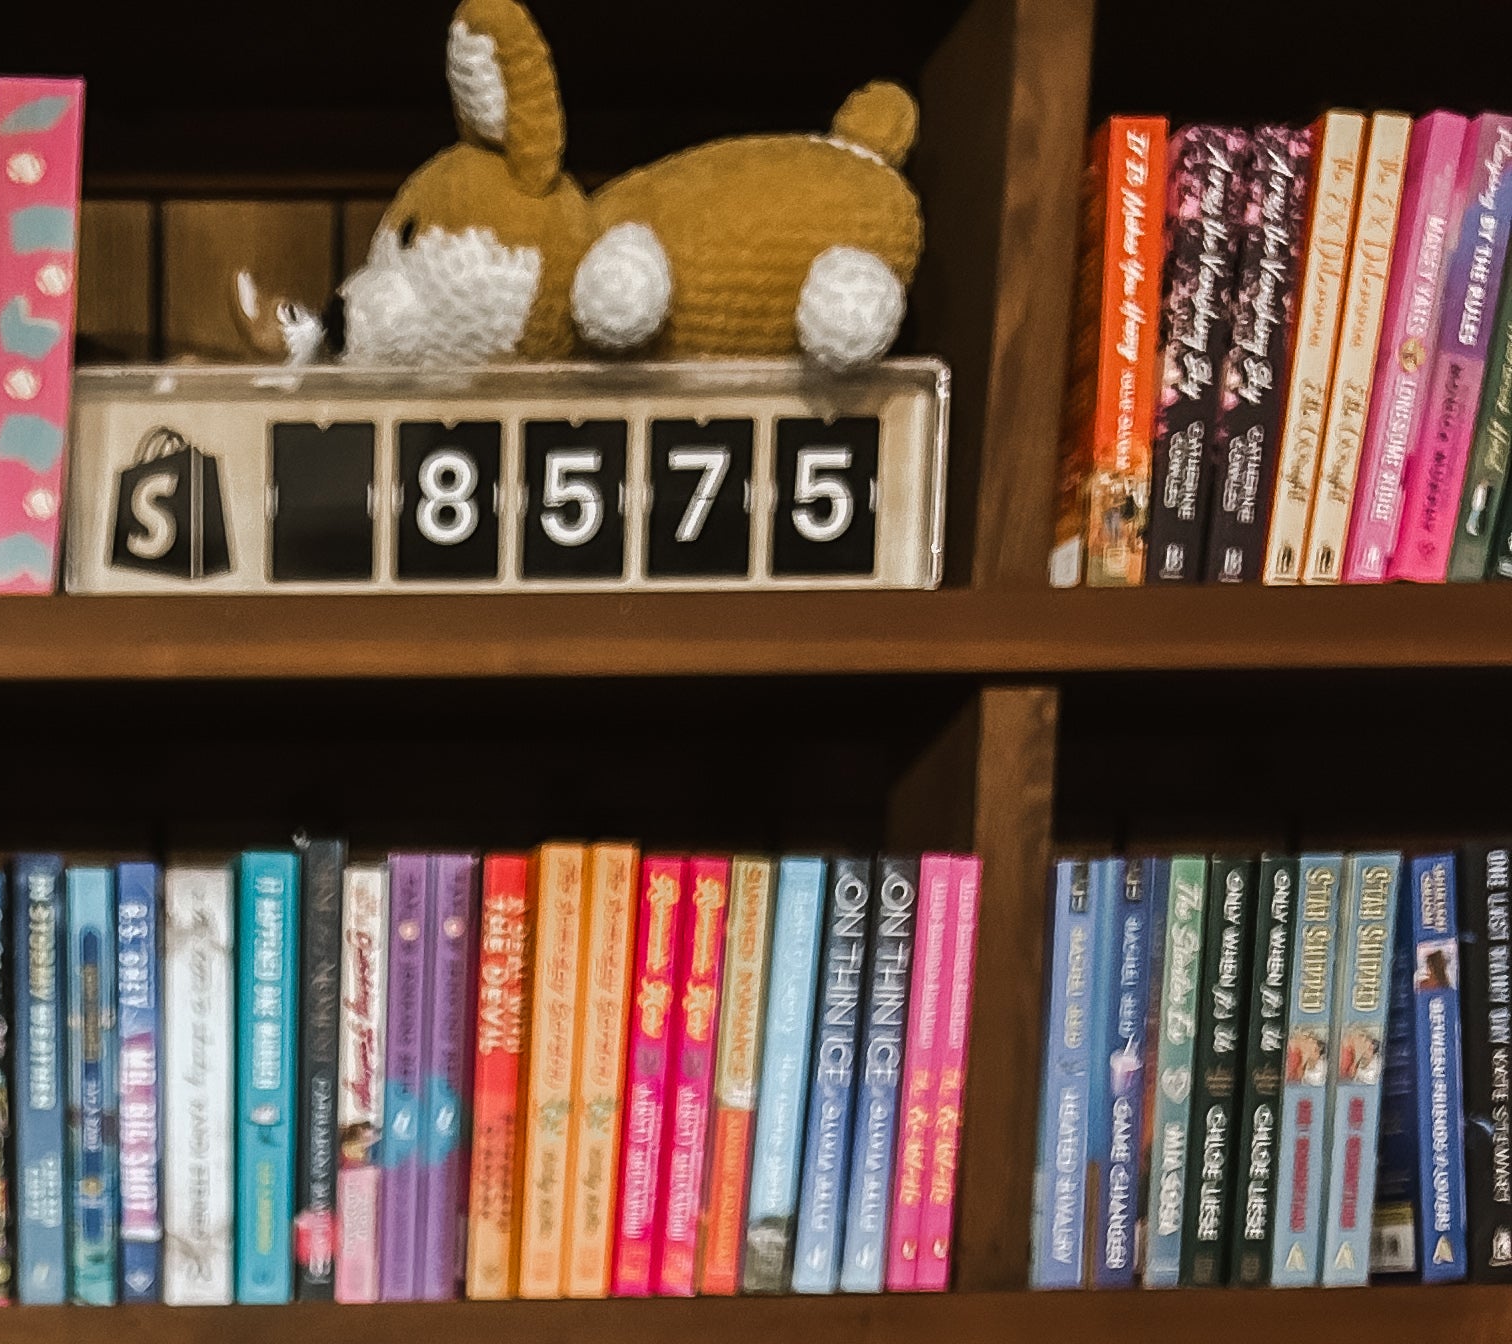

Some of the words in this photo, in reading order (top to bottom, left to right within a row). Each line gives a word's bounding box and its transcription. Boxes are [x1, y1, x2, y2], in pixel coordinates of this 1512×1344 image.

[1475, 212, 1496, 243] BY
[1467, 245, 1490, 282] THE
[1457, 286, 1486, 347] RULES
[1382, 377, 1418, 468] LONESOME
[1225, 870, 1244, 925] ONLY
[1270, 869, 1292, 924] ONLY
[1303, 867, 1337, 922] STAR
[1360, 865, 1393, 920] STAR
[1487, 850, 1510, 890] ONE
[832, 874, 869, 937] ON
[878, 874, 915, 937] ON
[1488, 893, 1509, 940] LAST
[823, 941, 859, 1026] THIN
[869, 941, 906, 1026] THIN
[1219, 927, 1241, 989] WHEN
[1265, 926, 1288, 988] WHEN
[1299, 924, 1334, 1014] SHIPPED
[1352, 924, 1388, 1013] SHIPPED
[817, 1034, 852, 1087] ICE
[865, 1035, 900, 1086] ICE
[1491, 1049, 1510, 1102] KATE
[1055, 1088, 1079, 1171] HEATED
[1111, 1098, 1132, 1161] GAME
[1204, 1105, 1226, 1180] CHLOE
[1248, 1104, 1275, 1180] CHLOE
[1492, 1107, 1510, 1204] STEWART
[1052, 1175, 1076, 1264] RIVALRY
[1105, 1164, 1130, 1269] CHANGER
[1197, 1182, 1222, 1241] LIESE
[1244, 1181, 1270, 1241] LIESE
